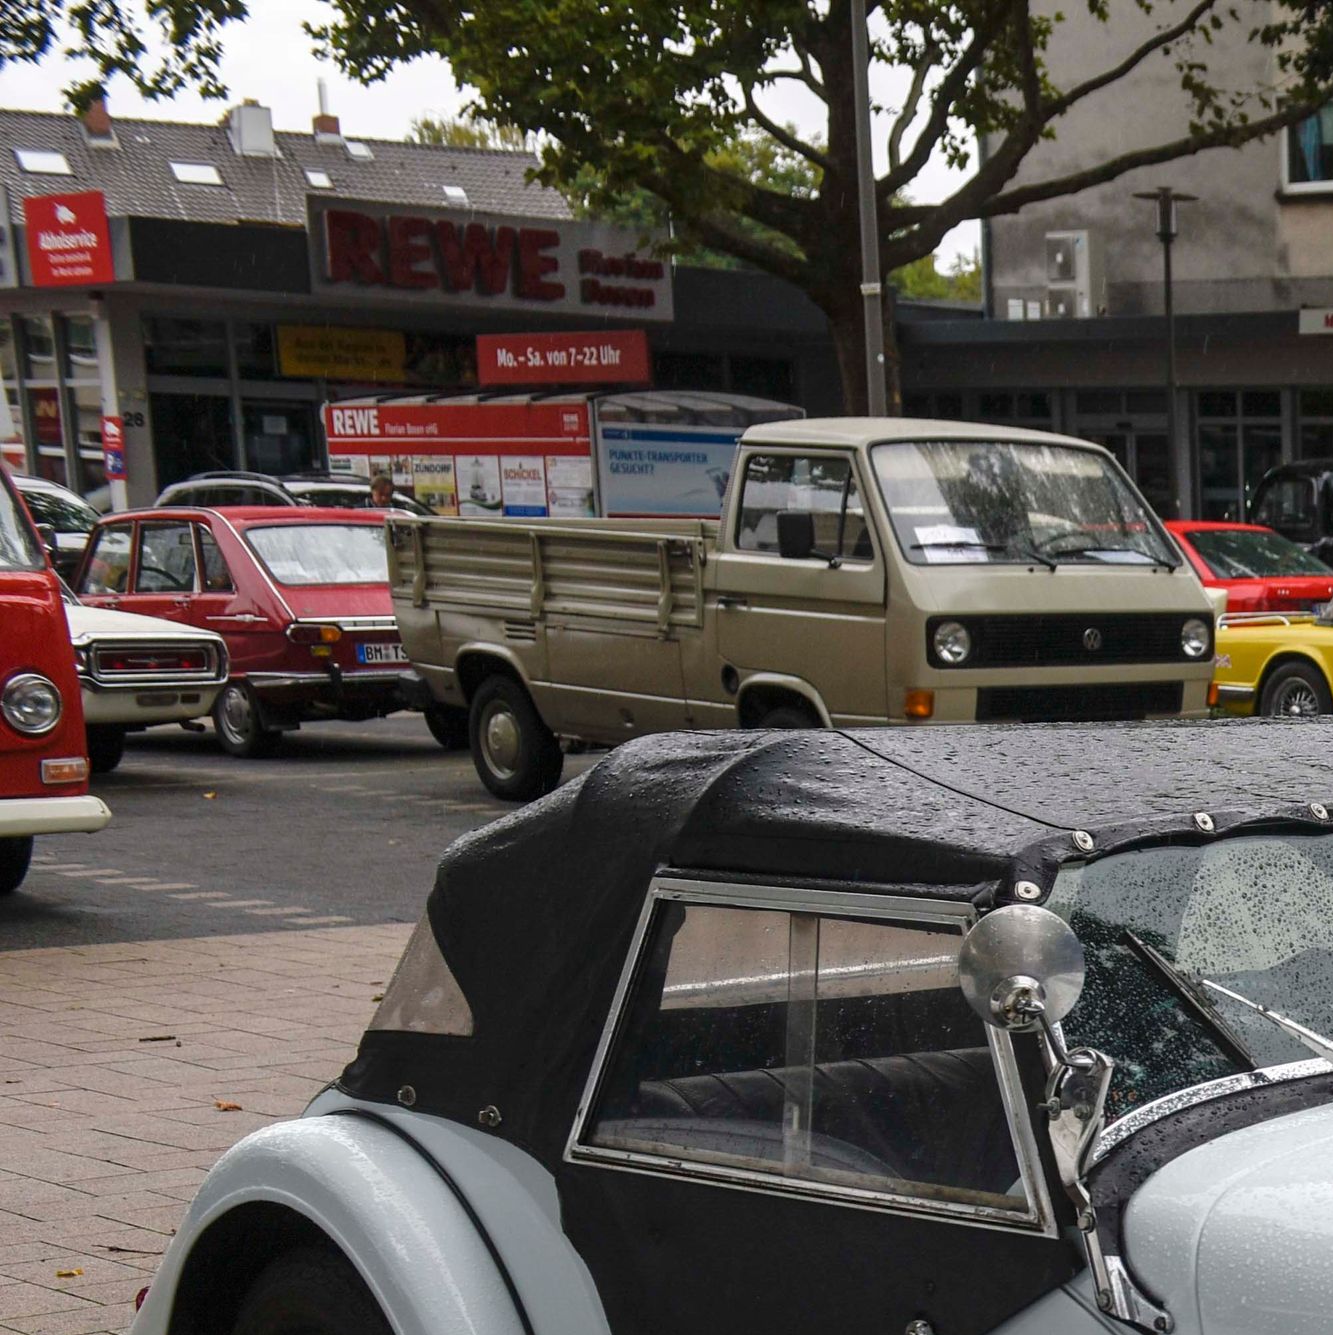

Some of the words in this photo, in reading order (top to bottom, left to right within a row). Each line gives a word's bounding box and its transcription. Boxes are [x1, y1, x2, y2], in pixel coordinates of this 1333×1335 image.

[324, 209, 566, 302] REWE
[546, 350, 567, 365] von
[600, 345, 621, 365] Uhr
[332, 408, 380, 436] REWE
[365, 646, 383, 660] BM
